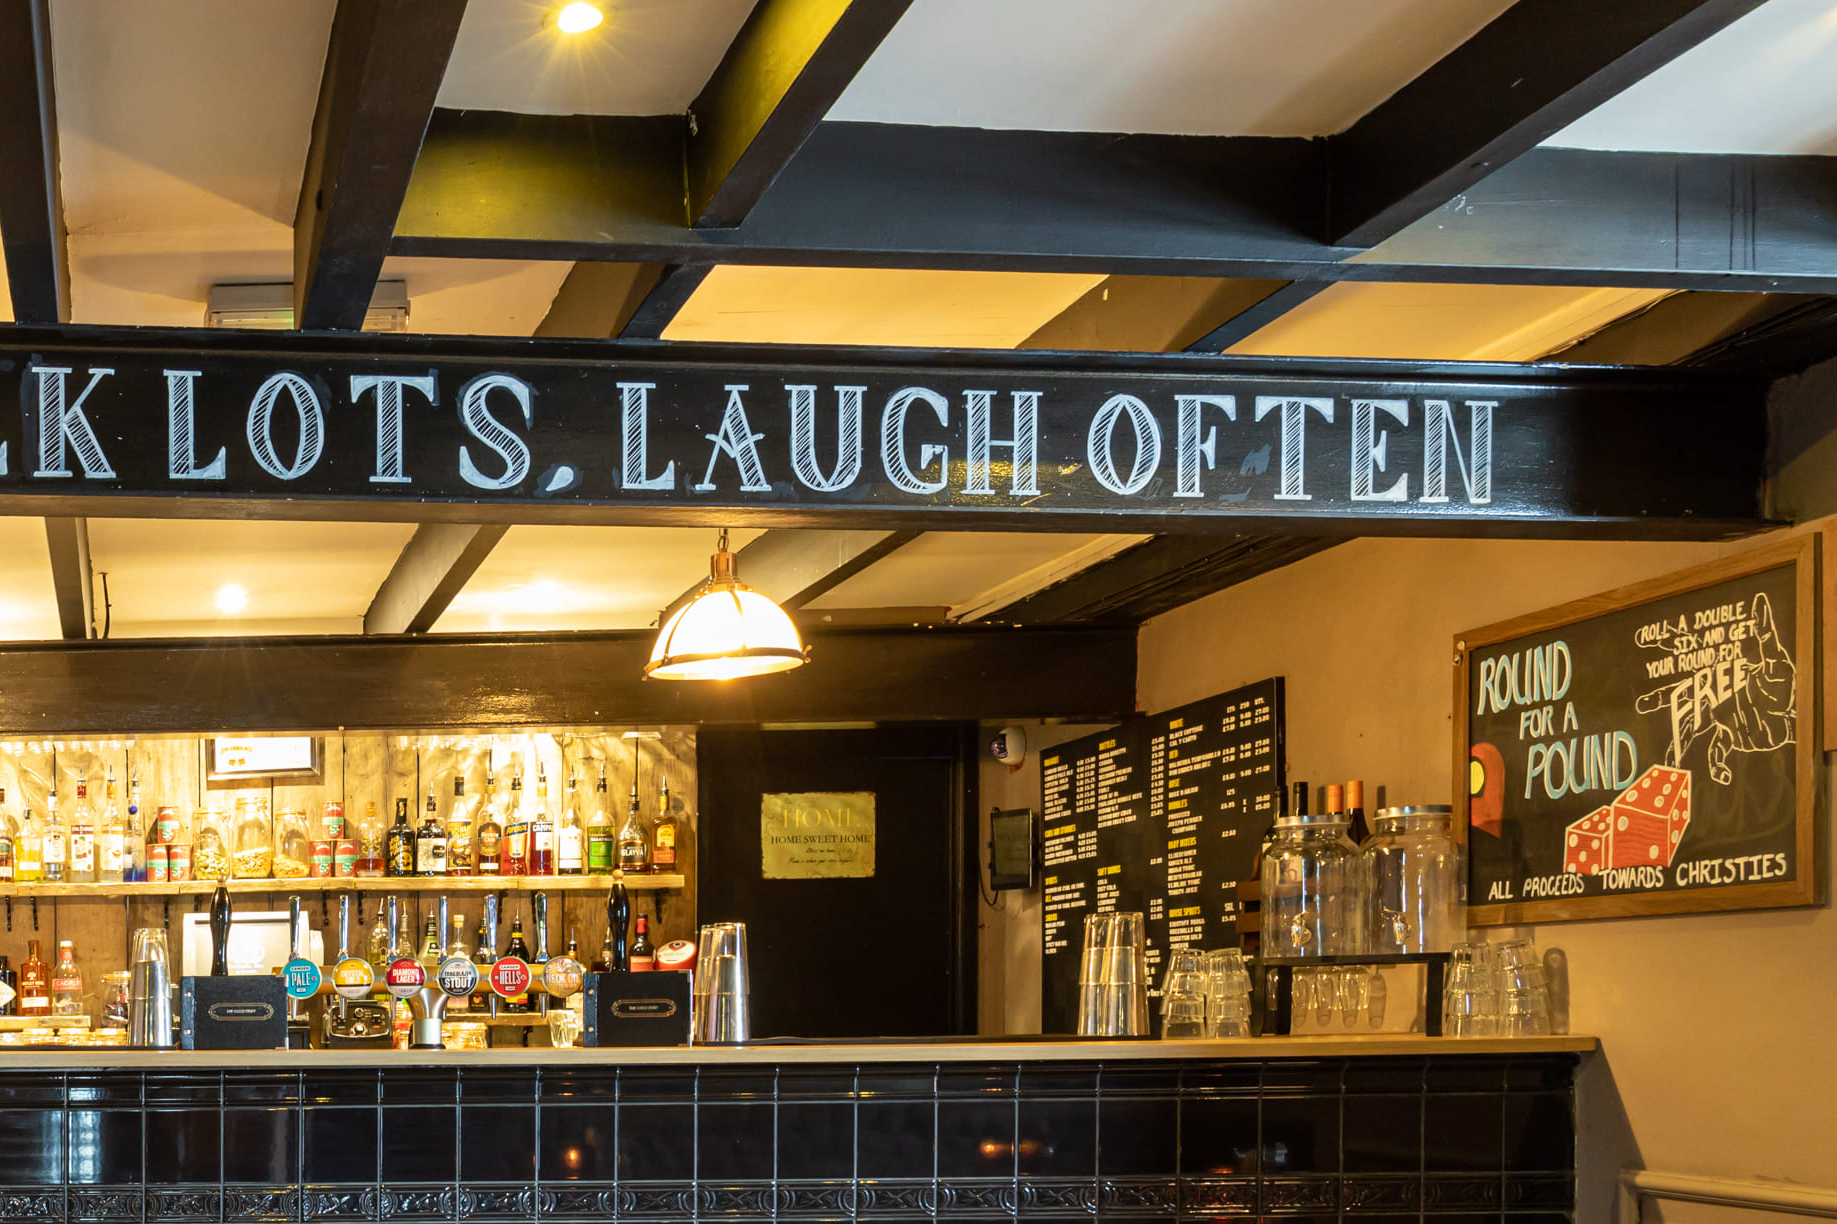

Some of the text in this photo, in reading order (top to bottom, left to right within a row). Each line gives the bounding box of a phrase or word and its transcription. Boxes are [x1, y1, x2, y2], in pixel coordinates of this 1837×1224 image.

[163, 369, 575, 493] LOTS,
[615, 382, 1042, 498] LAUGH
[1086, 391, 1500, 505] OFTEN
[1641, 601, 1746, 644] ROLL A DOUBLE
[1673, 619, 1755, 655] SIX AND GET
[1477, 640, 1571, 715] ROUND
[1646, 641, 1743, 679] YOUR ROUND FOR
[1520, 701, 1578, 740] FOR A
[1671, 658, 1747, 769] FREE
[1525, 731, 1637, 799] POUND
[771, 835, 870, 844] HOME SWEET HOME
[1488, 853, 1787, 900] ALL PROCEEDS TOWARDS CHRISTIES
[291, 973, 311, 986] PALE
[396, 975, 415, 983] LAGER
[444, 977, 471, 989] STOUT
[499, 971, 521, 985] HELLS
